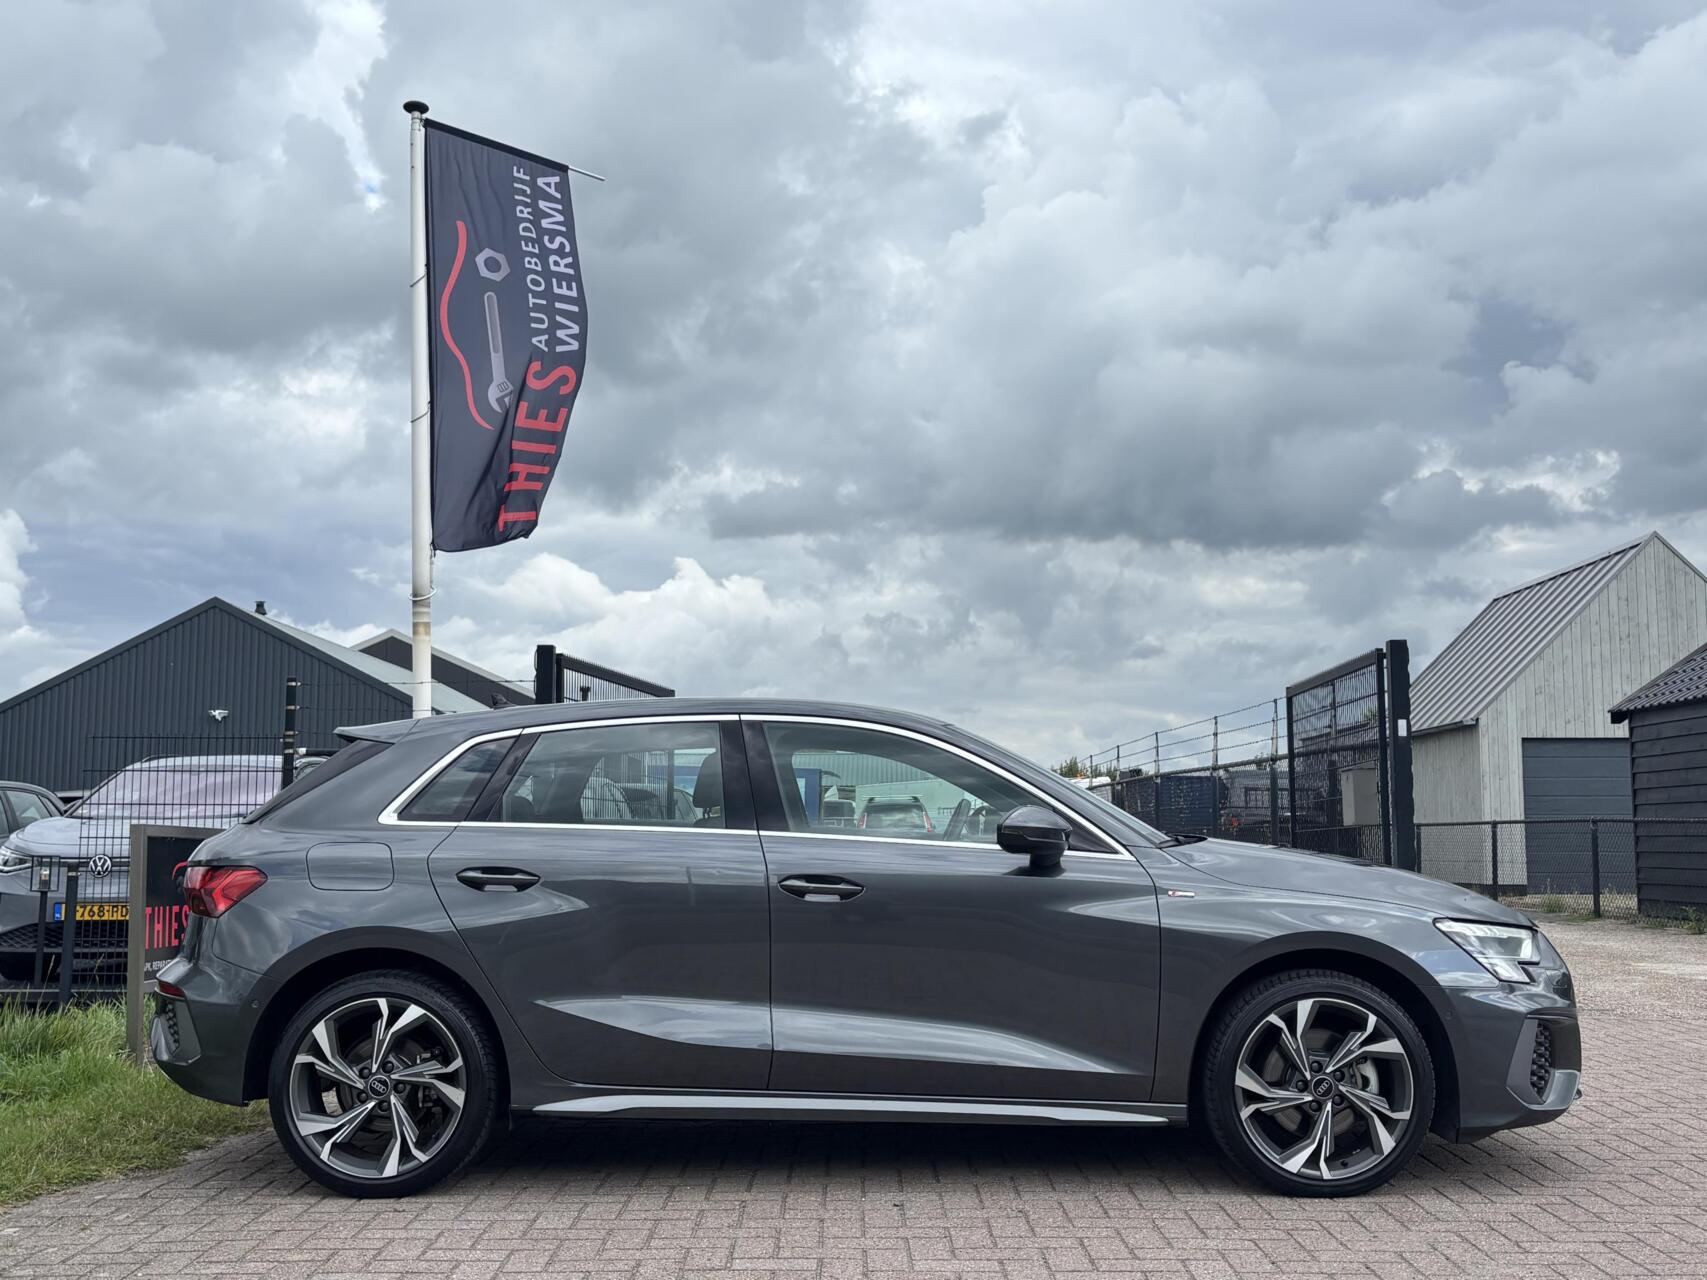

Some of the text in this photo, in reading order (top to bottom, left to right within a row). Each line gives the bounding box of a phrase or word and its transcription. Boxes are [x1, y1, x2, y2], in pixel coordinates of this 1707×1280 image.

[513, 165, 549, 352] AUTOBEDRIJF
[537, 175, 580, 354] WIERSMA
[498, 360, 577, 532] THIES
